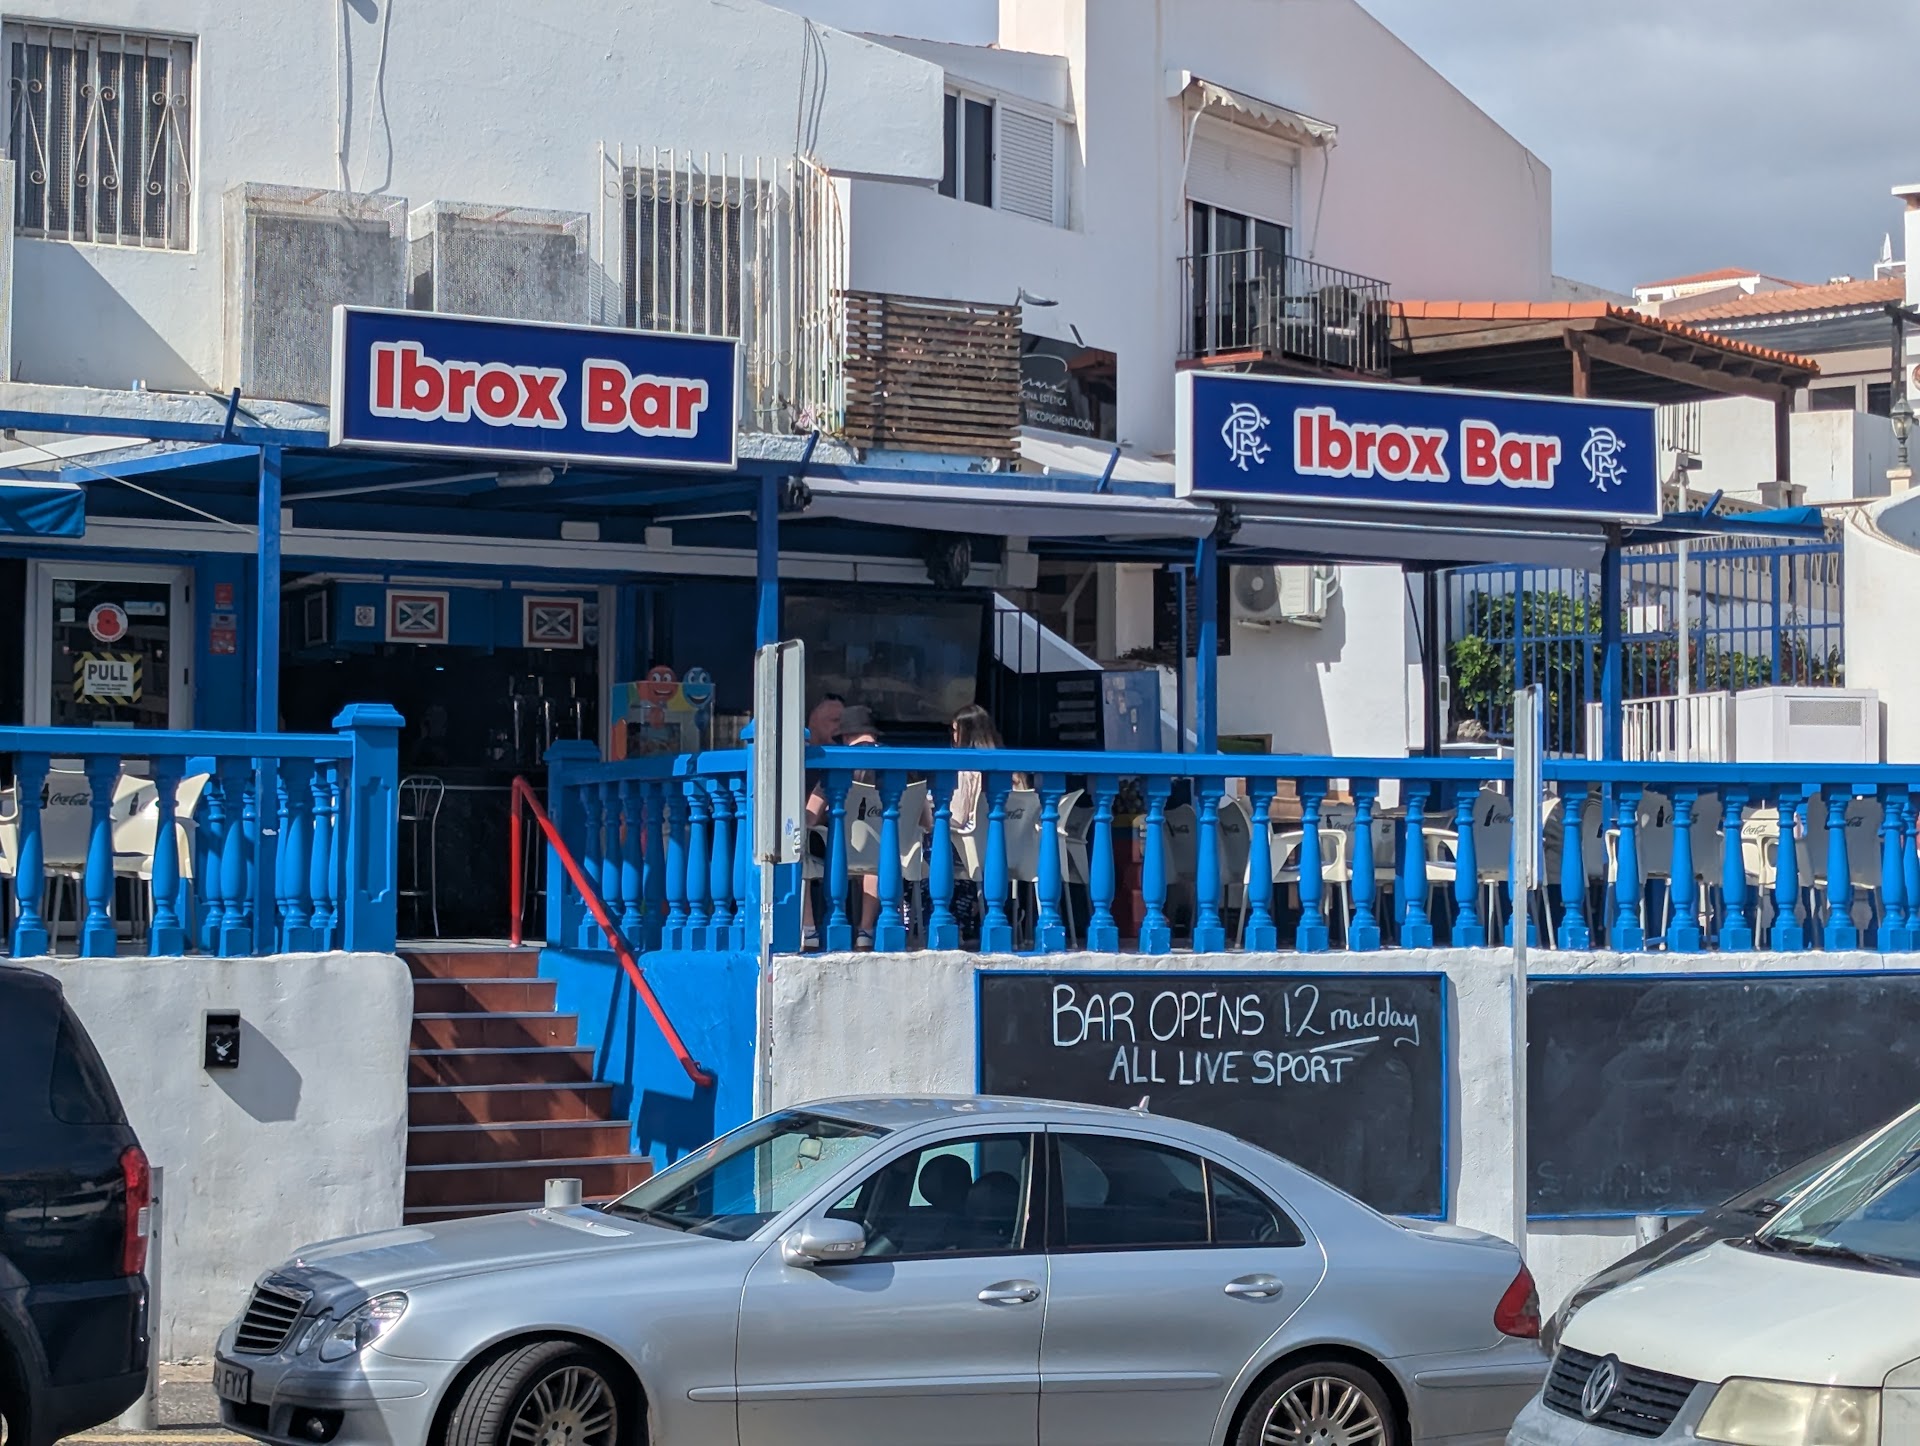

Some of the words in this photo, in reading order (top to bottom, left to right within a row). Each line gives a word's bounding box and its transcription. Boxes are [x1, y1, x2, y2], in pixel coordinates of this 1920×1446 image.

[372, 344, 564, 427] Ibrox
[584, 361, 706, 436] Bar
[1296, 408, 1448, 482] Ibrox
[1462, 421, 1560, 487] Bar
[88, 664, 128, 681] PULL
[1052, 984, 1135, 1047] BAR
[1149, 991, 1265, 1041] OPENS
[1284, 984, 1325, 1037] 12
[1330, 997, 1419, 1047] midday
[1109, 1045, 1165, 1083] ALL
[1178, 1050, 1243, 1085] LIVE
[1252, 1050, 1353, 1086] SPORT
[224, 1370, 247, 1397] FYX
